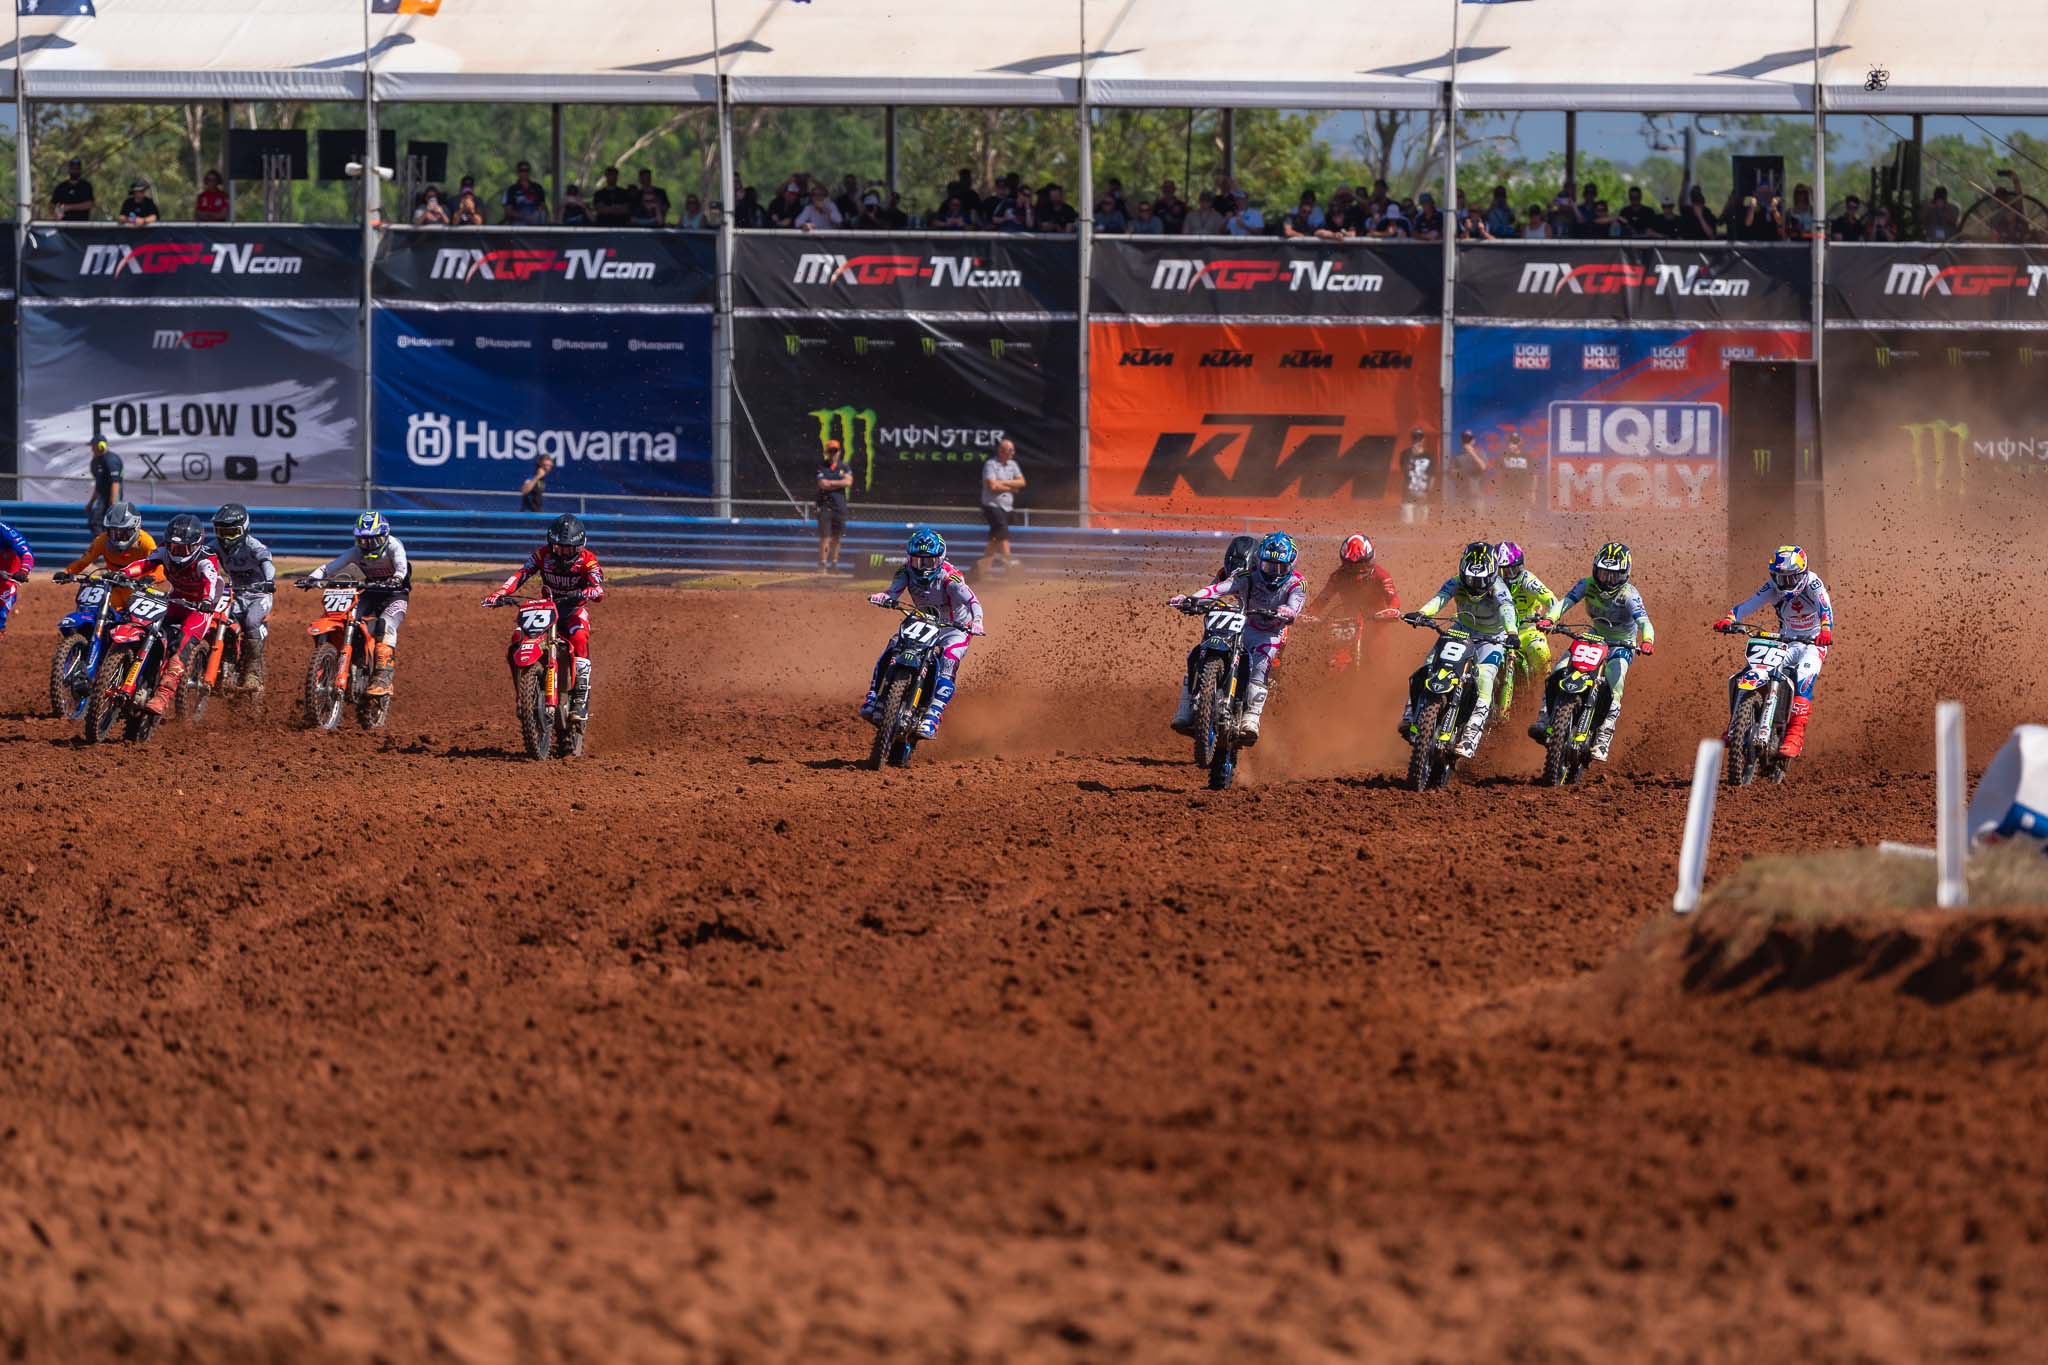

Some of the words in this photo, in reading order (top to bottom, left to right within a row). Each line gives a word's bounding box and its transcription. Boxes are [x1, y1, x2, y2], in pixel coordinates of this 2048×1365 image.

[1884, 263, 2048, 299] MXGP-T
[151, 329, 230, 350] MXGP
[1119, 347, 1174, 366] KTM
[1199, 348, 1254, 367] KTM
[1279, 349, 1333, 368] KTM
[1358, 350, 1413, 369] KTM
[1516, 345, 1549, 356] LIQUI
[1584, 345, 1618, 356] LIQUI
[1653, 347, 1687, 358] LIQUI
[1722, 348, 1754, 359] LIQUI
[1515, 357, 1549, 368] MOLY
[1584, 357, 1618, 368] MOLY
[1653, 358, 1687, 369] MOLY
[92, 402, 238, 437] FOLLOW
[252, 404, 297, 438] US
[1558, 408, 1711, 456] LIQUI
[456, 420, 677, 467] Husqvarna
[1134, 413, 1397, 497] KTM
[1558, 462, 1714, 508] MOLY
[78, 587, 104, 603] 43
[325, 594, 353, 612] 275
[128, 598, 167, 618] 137
[521, 609, 552, 629] 73
[1207, 611, 1245, 632] 772
[903, 621, 939, 643] 47
[1440, 641, 1467, 662] 8
[1572, 644, 1603, 666] 99
[1751, 645, 1785, 666] 26
